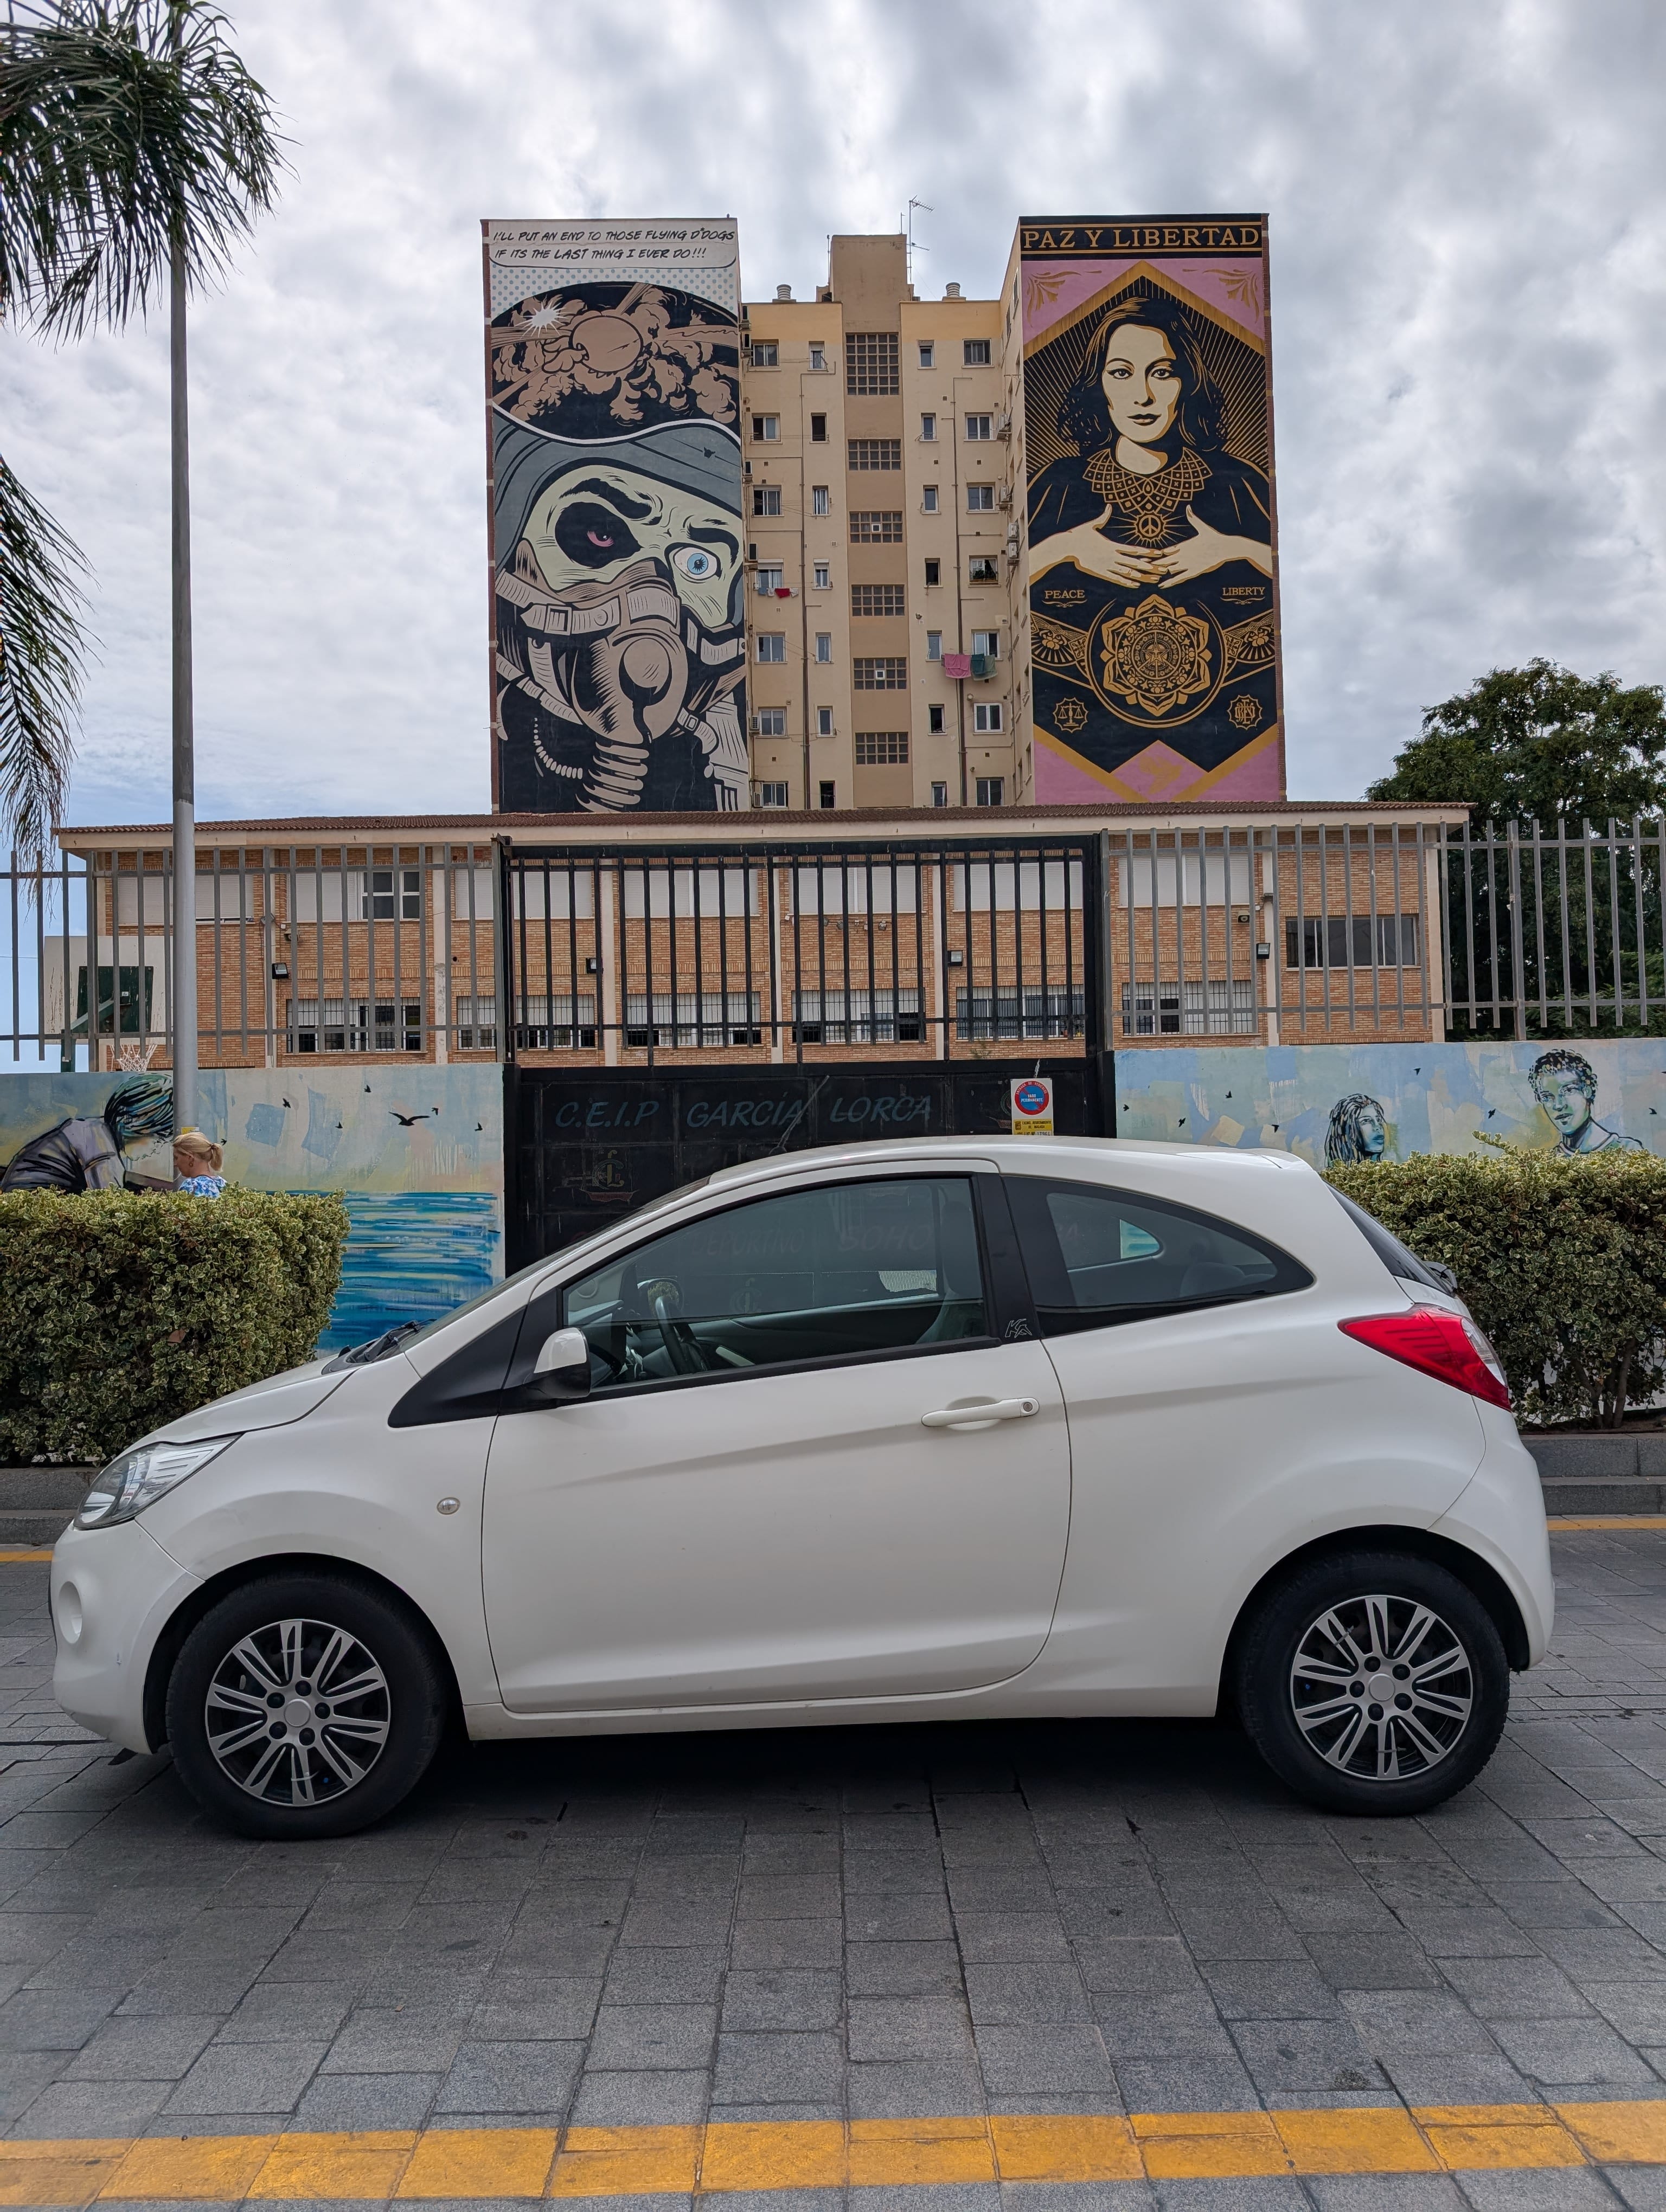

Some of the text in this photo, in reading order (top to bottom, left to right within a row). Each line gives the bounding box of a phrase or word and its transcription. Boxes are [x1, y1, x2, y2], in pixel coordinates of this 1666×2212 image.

[494, 232, 514, 241] I'LL
[518, 232, 540, 241] PUT
[542, 232, 558, 241] AN
[560, 231, 585, 241] END
[587, 232, 601, 241] TO
[605, 230, 642, 241] THOSE
[645, 230, 688, 241] FLYING
[1023, 227, 1259, 248] PAZ Y LIBERTAD
[495, 247, 707, 260] IF ITS THE LAST THING I EVER DO!!!
[1045, 589, 1085, 599] PEACE
[1222, 587, 1265, 596] LIBERTY
[555, 1092, 932, 1127] C.E.I.P GARCÍA LORCA
[691, 1225, 932, 1256] DEPORTIVO SOHO
